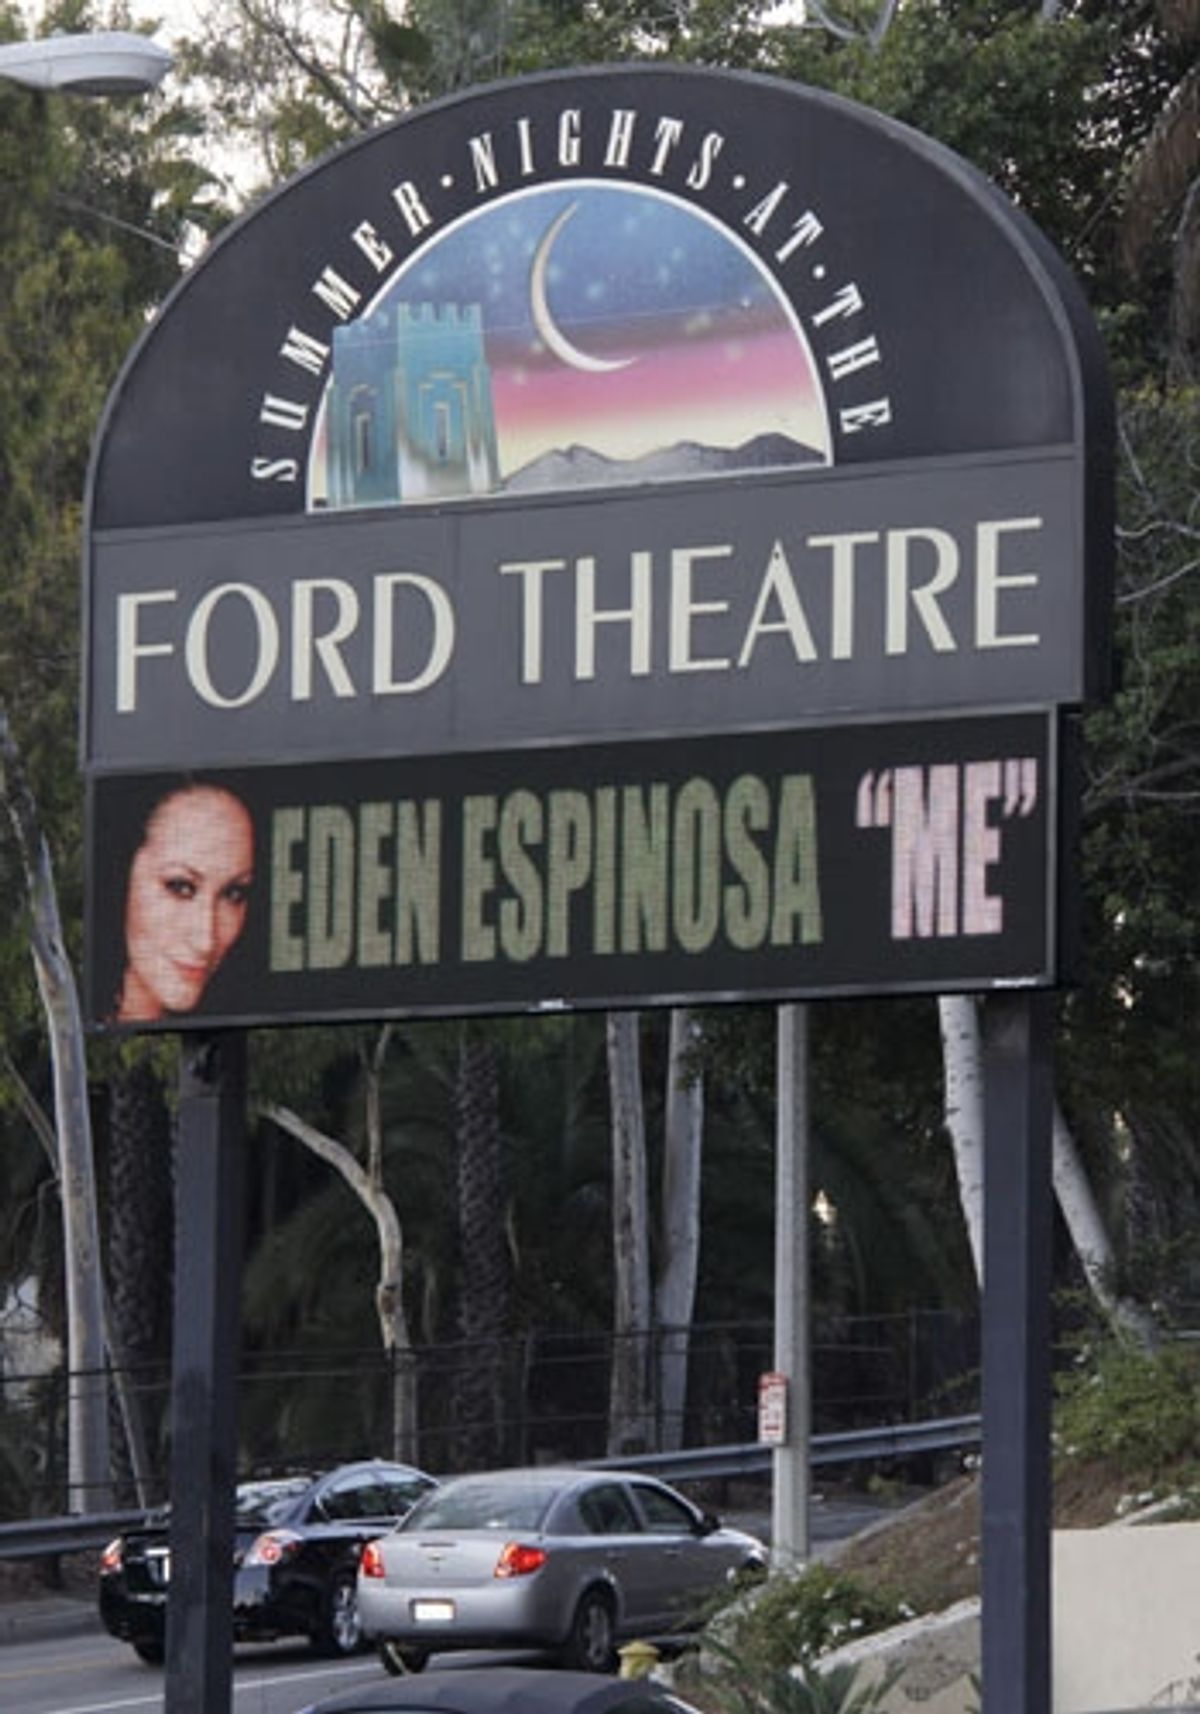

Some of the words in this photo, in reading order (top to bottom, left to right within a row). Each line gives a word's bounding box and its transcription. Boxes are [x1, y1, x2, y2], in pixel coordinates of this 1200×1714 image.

[252, 180, 433, 483] SUMMER
[468, 108, 724, 194] NIGHTS
[744, 181, 825, 264] AT
[812, 281, 892, 434] THE
[115, 571, 456, 714] FORD
[499, 516, 1045, 685] THEATRE
[268, 798, 442, 973] EDEN
[460, 774, 824, 964] ESPINOSA
